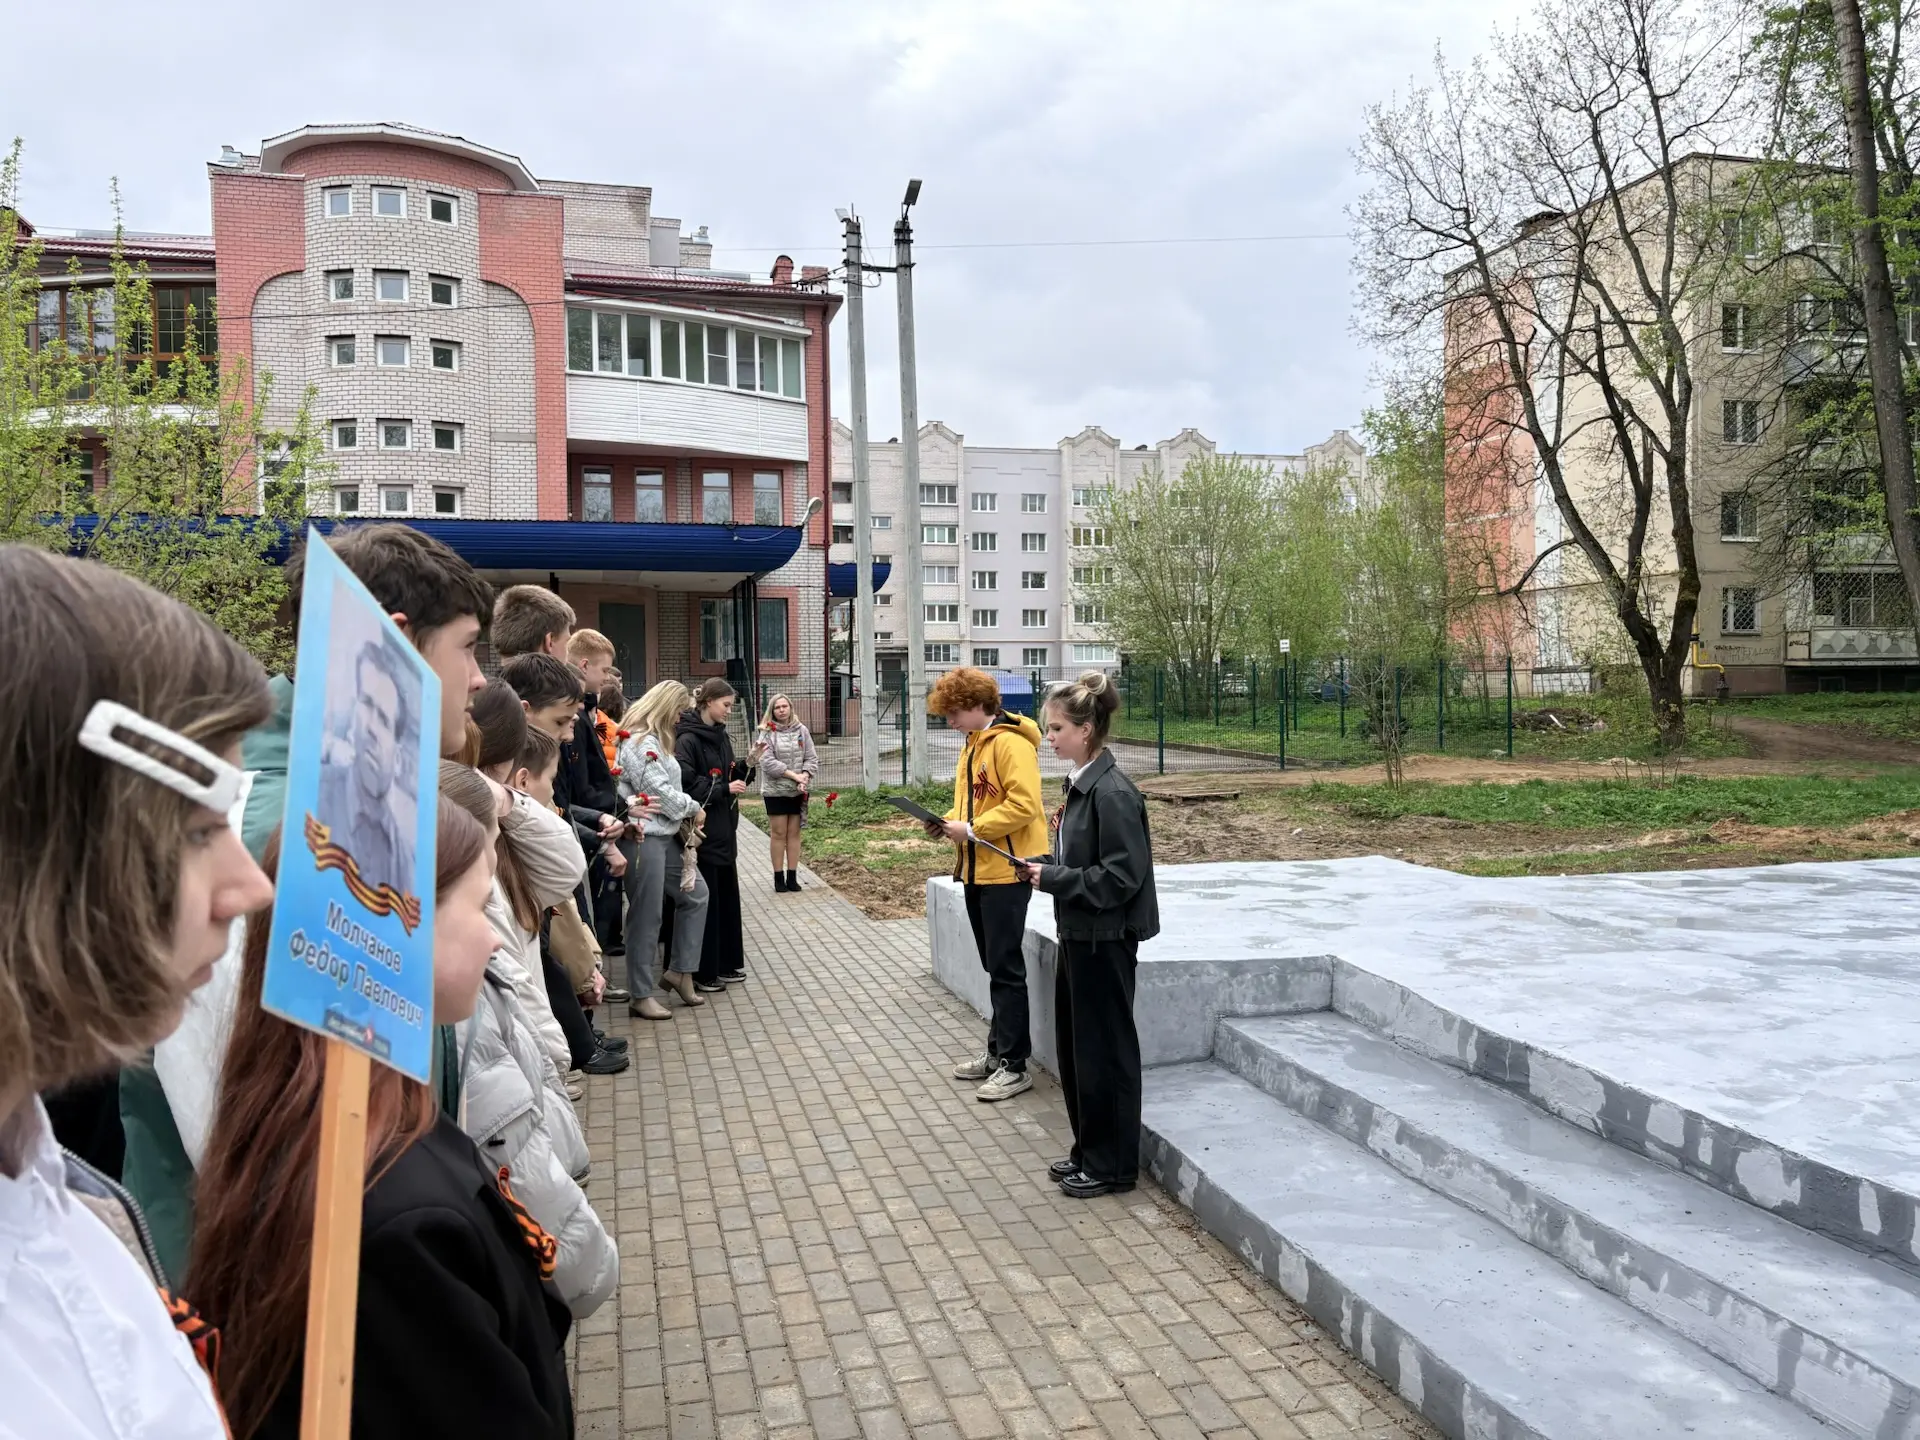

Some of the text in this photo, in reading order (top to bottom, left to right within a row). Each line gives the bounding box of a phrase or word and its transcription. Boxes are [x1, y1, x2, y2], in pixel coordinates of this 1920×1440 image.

[290, 929, 423, 1029] Федор Павлович
[327, 900, 402, 974] Молчанов
